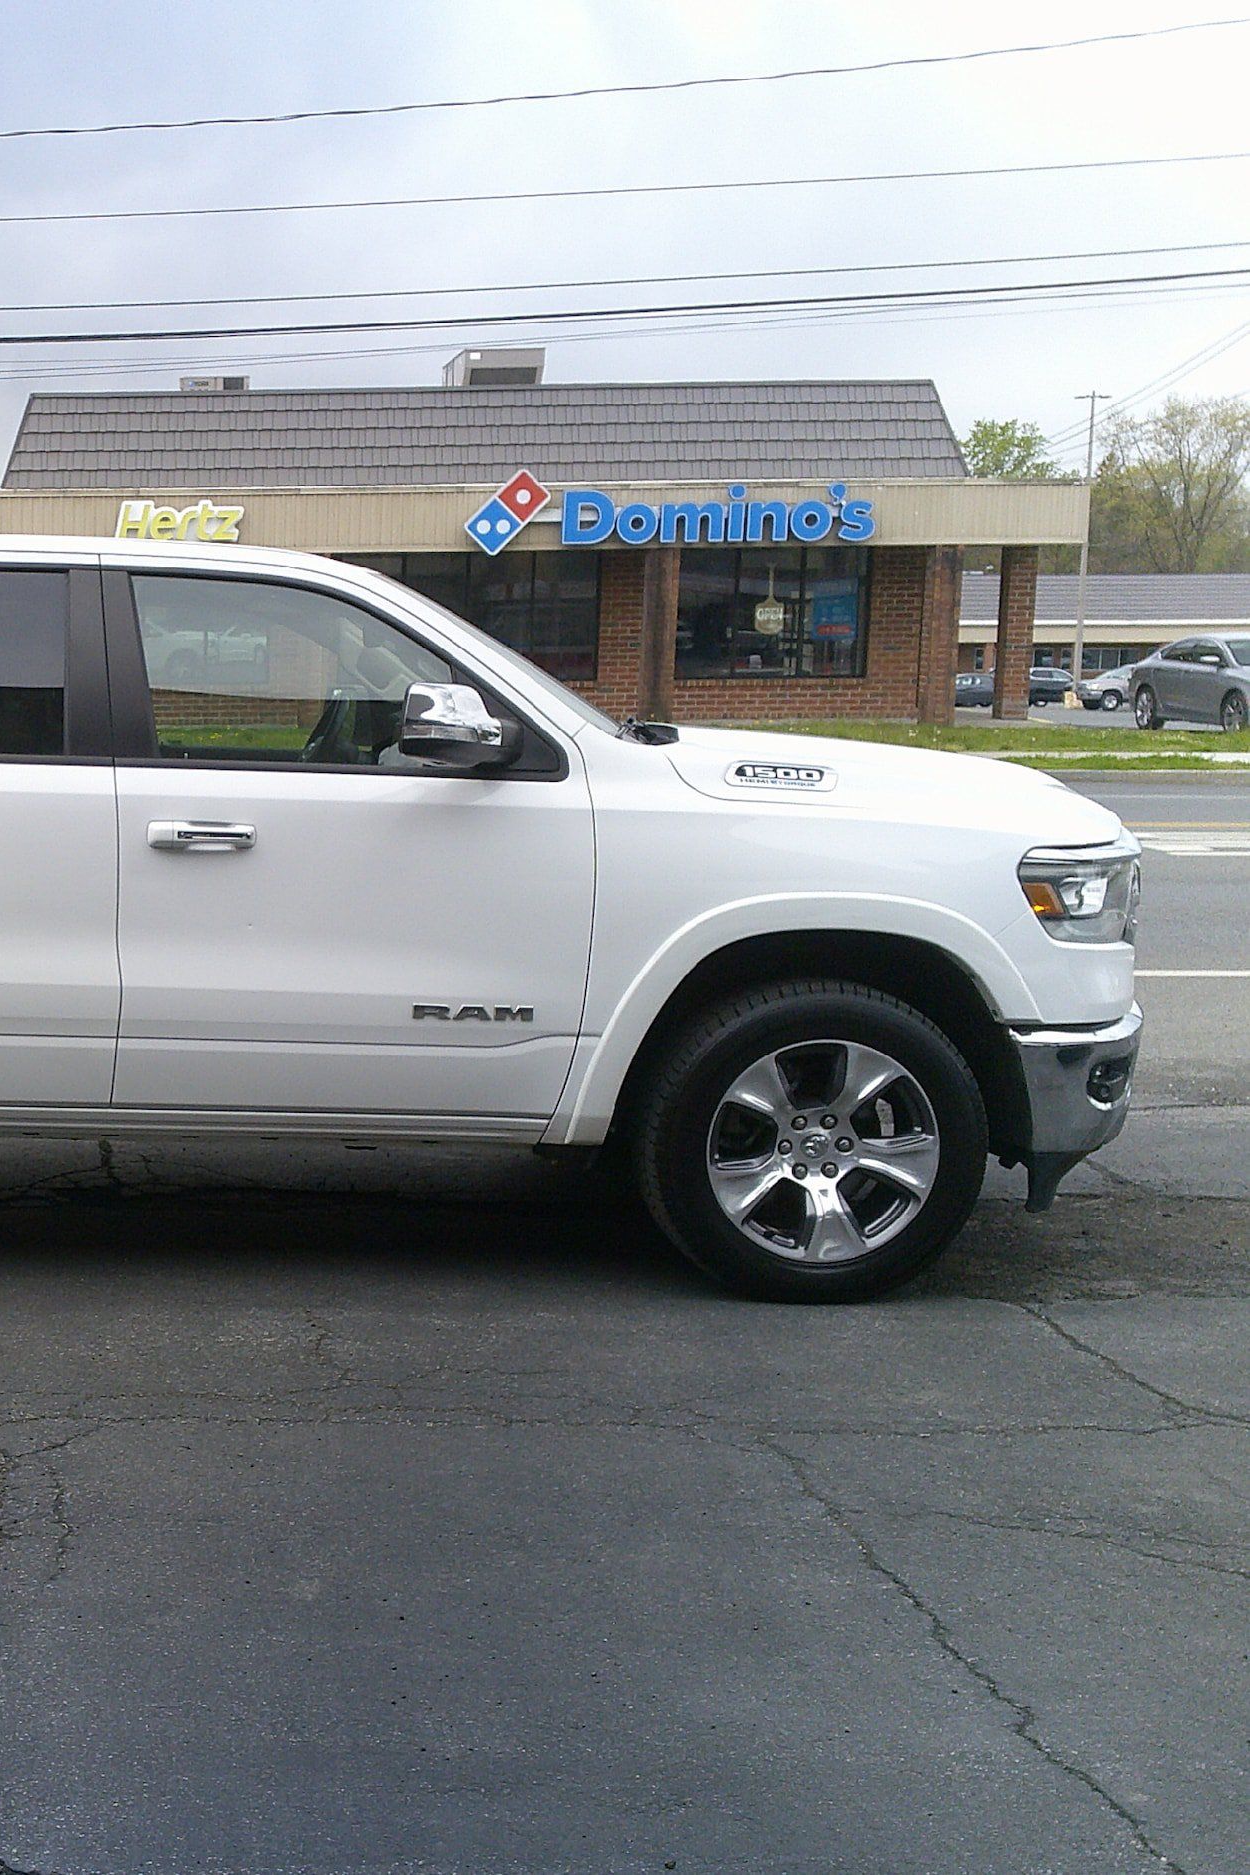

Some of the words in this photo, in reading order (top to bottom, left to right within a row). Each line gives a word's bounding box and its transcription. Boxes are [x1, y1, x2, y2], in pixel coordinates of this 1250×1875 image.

[117, 501, 242, 541] Hertz
[562, 482, 876, 544] Domino's
[742, 766, 823, 781] 1500
[412, 1003, 535, 1021] RAM
